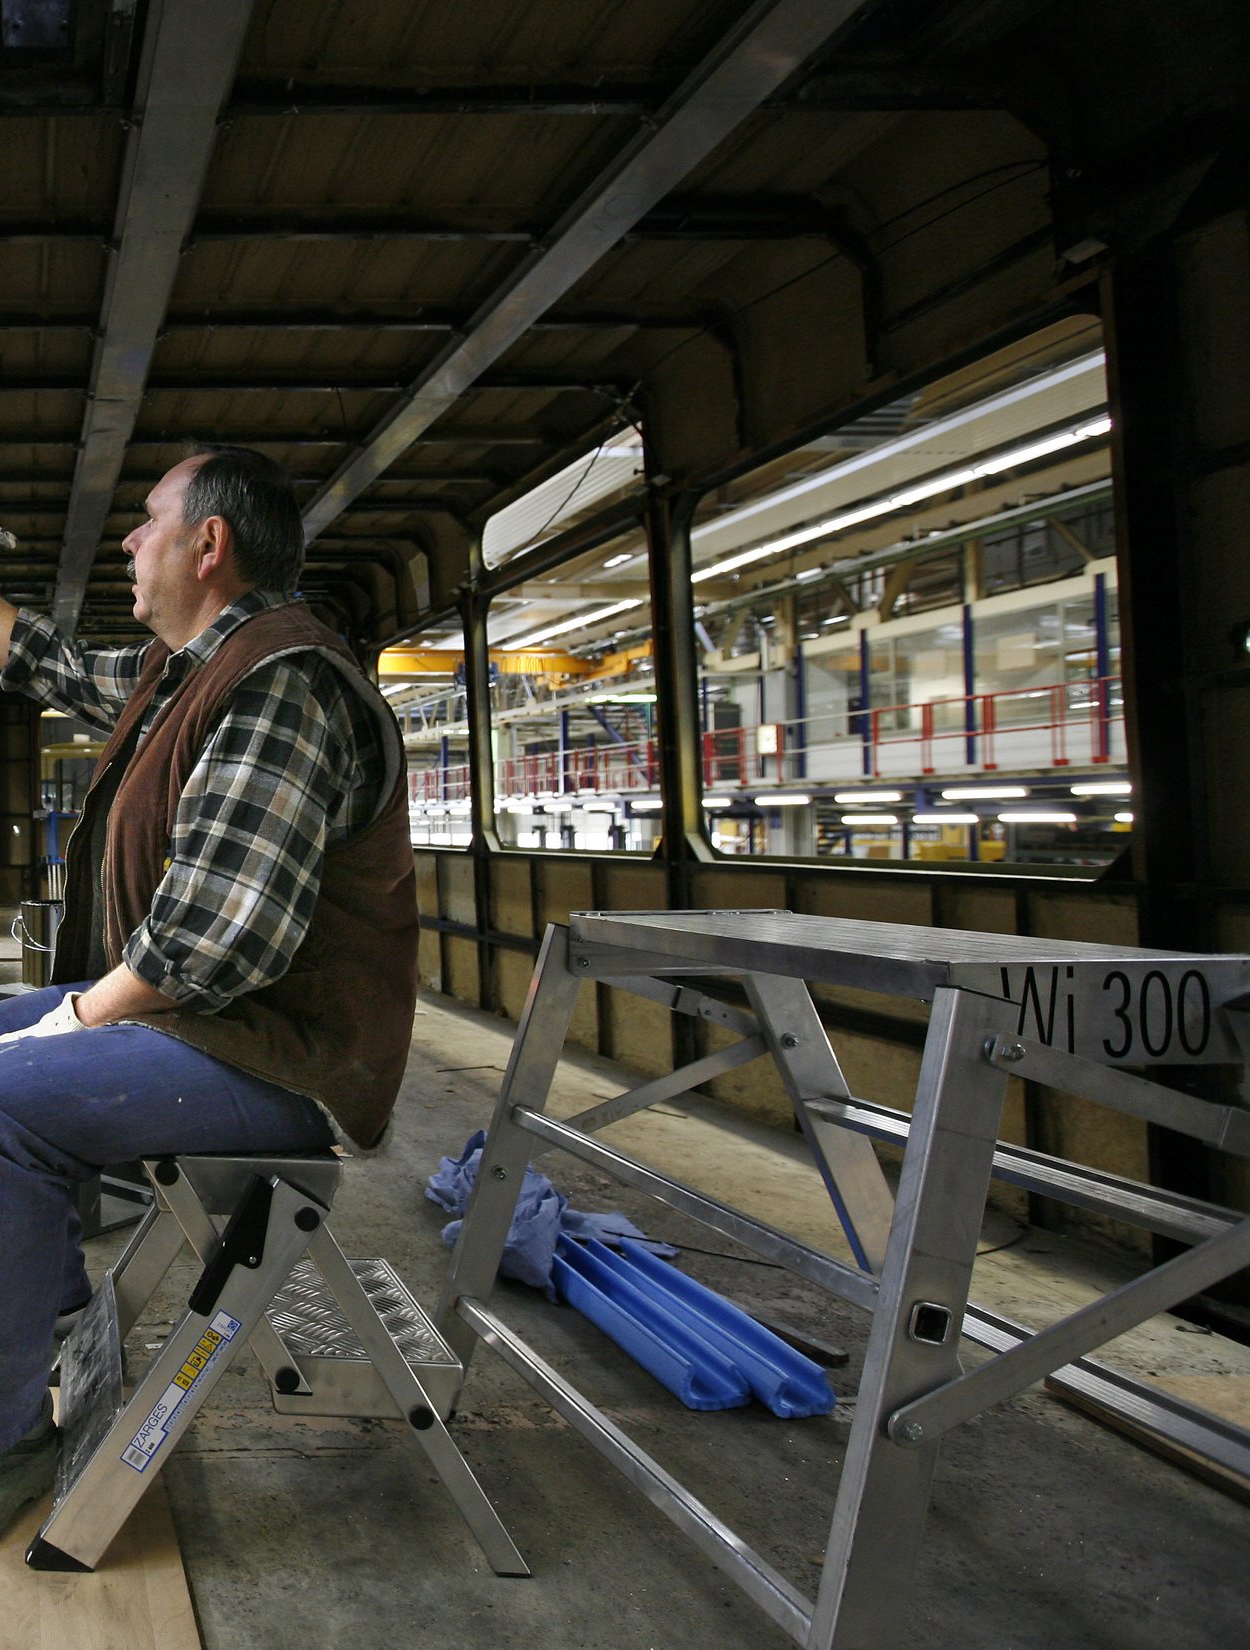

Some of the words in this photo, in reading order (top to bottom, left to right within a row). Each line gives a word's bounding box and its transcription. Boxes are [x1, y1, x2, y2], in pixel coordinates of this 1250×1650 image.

[1000, 965, 1075, 1055] Wi
[1102, 969, 1211, 1058] 300
[133, 1403, 168, 1449] ZARGES
